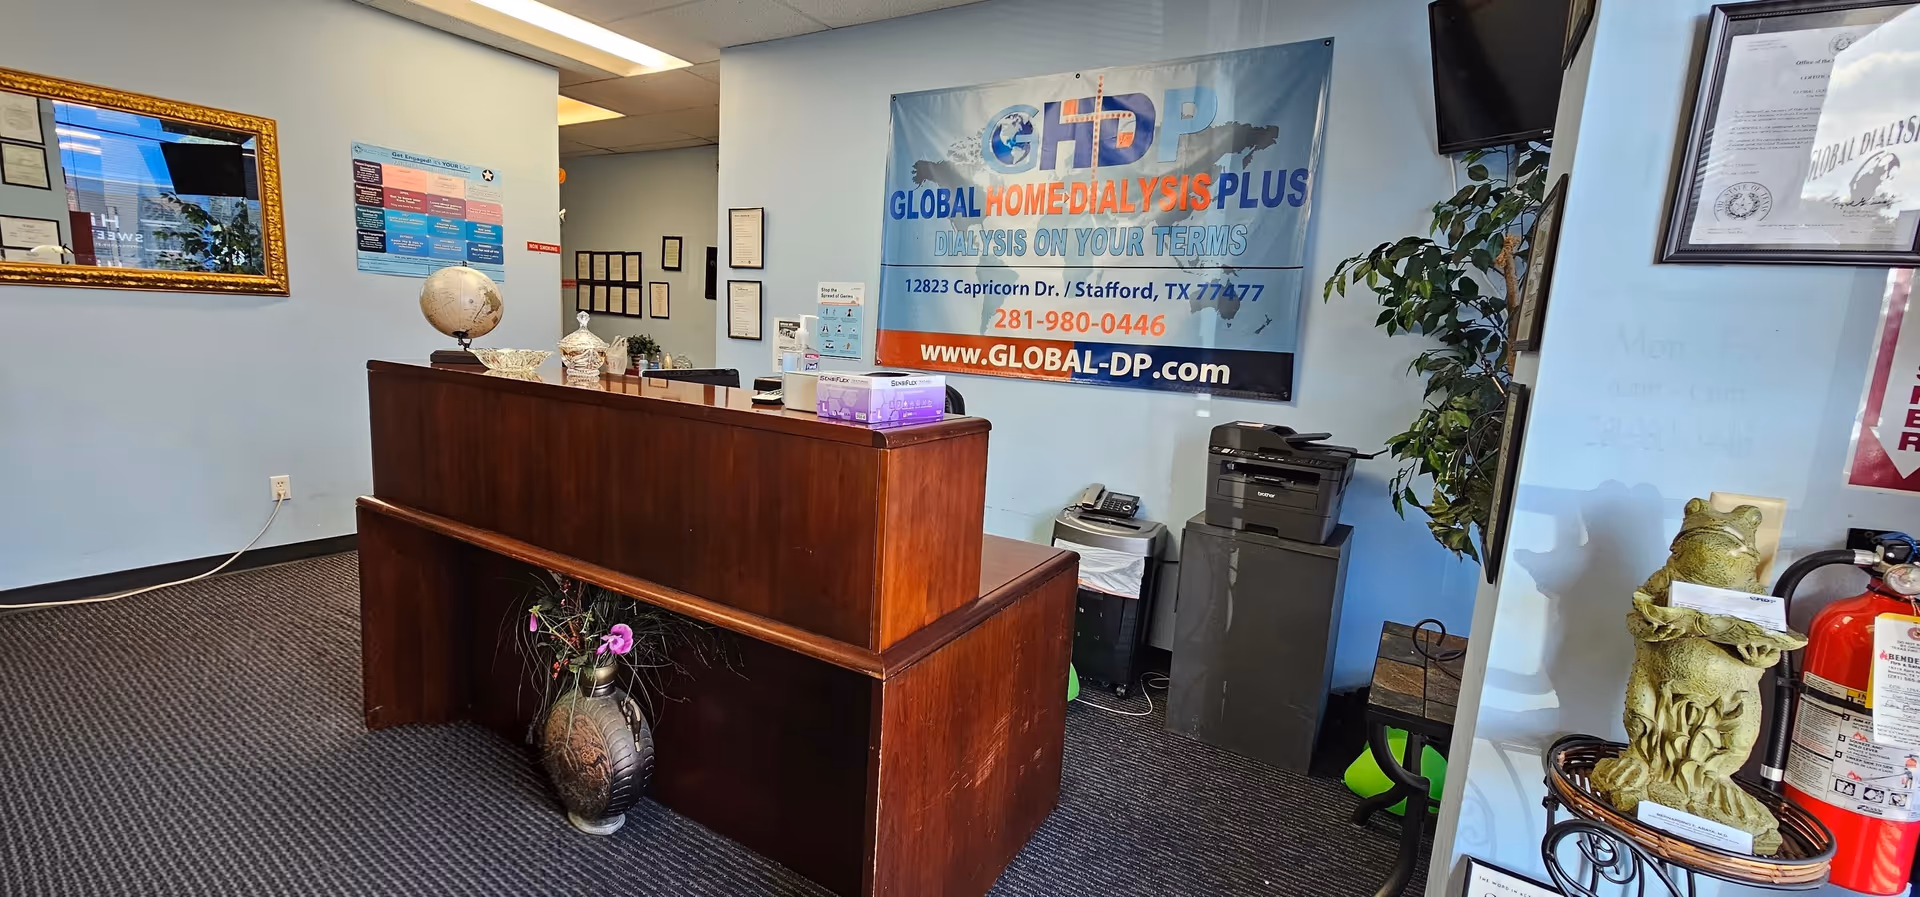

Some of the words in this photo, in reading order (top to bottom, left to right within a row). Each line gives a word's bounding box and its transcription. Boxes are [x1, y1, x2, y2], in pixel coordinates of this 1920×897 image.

[982, 86, 1218, 175] GHDP
[442, 161, 459, 169] YOUR
[890, 186, 980, 220] GLOBAL
[1217, 168, 1310, 210] PLUS
[934, 228, 1028, 256] DIALYSIS
[1034, 228, 1068, 256] ON
[1074, 226, 1144, 257] YOUR
[1152, 224, 1248, 257] TERMS
[905, 278, 949, 293] 12823
[954, 279, 1030, 298] Capricorn
[1034, 280, 1060, 297] Dr.
[1075, 281, 1159, 302] Stafford,
[1164, 282, 1192, 300] TX
[1196, 282, 1265, 302] 77477
[994, 308, 1166, 337] 281-980-0446
[920, 344, 1231, 384] www.GLOBAL-DP.com
[822, 402, 828, 412] L
[877, 410, 882, 419] L
[1492, 881, 1509, 891] WORD
